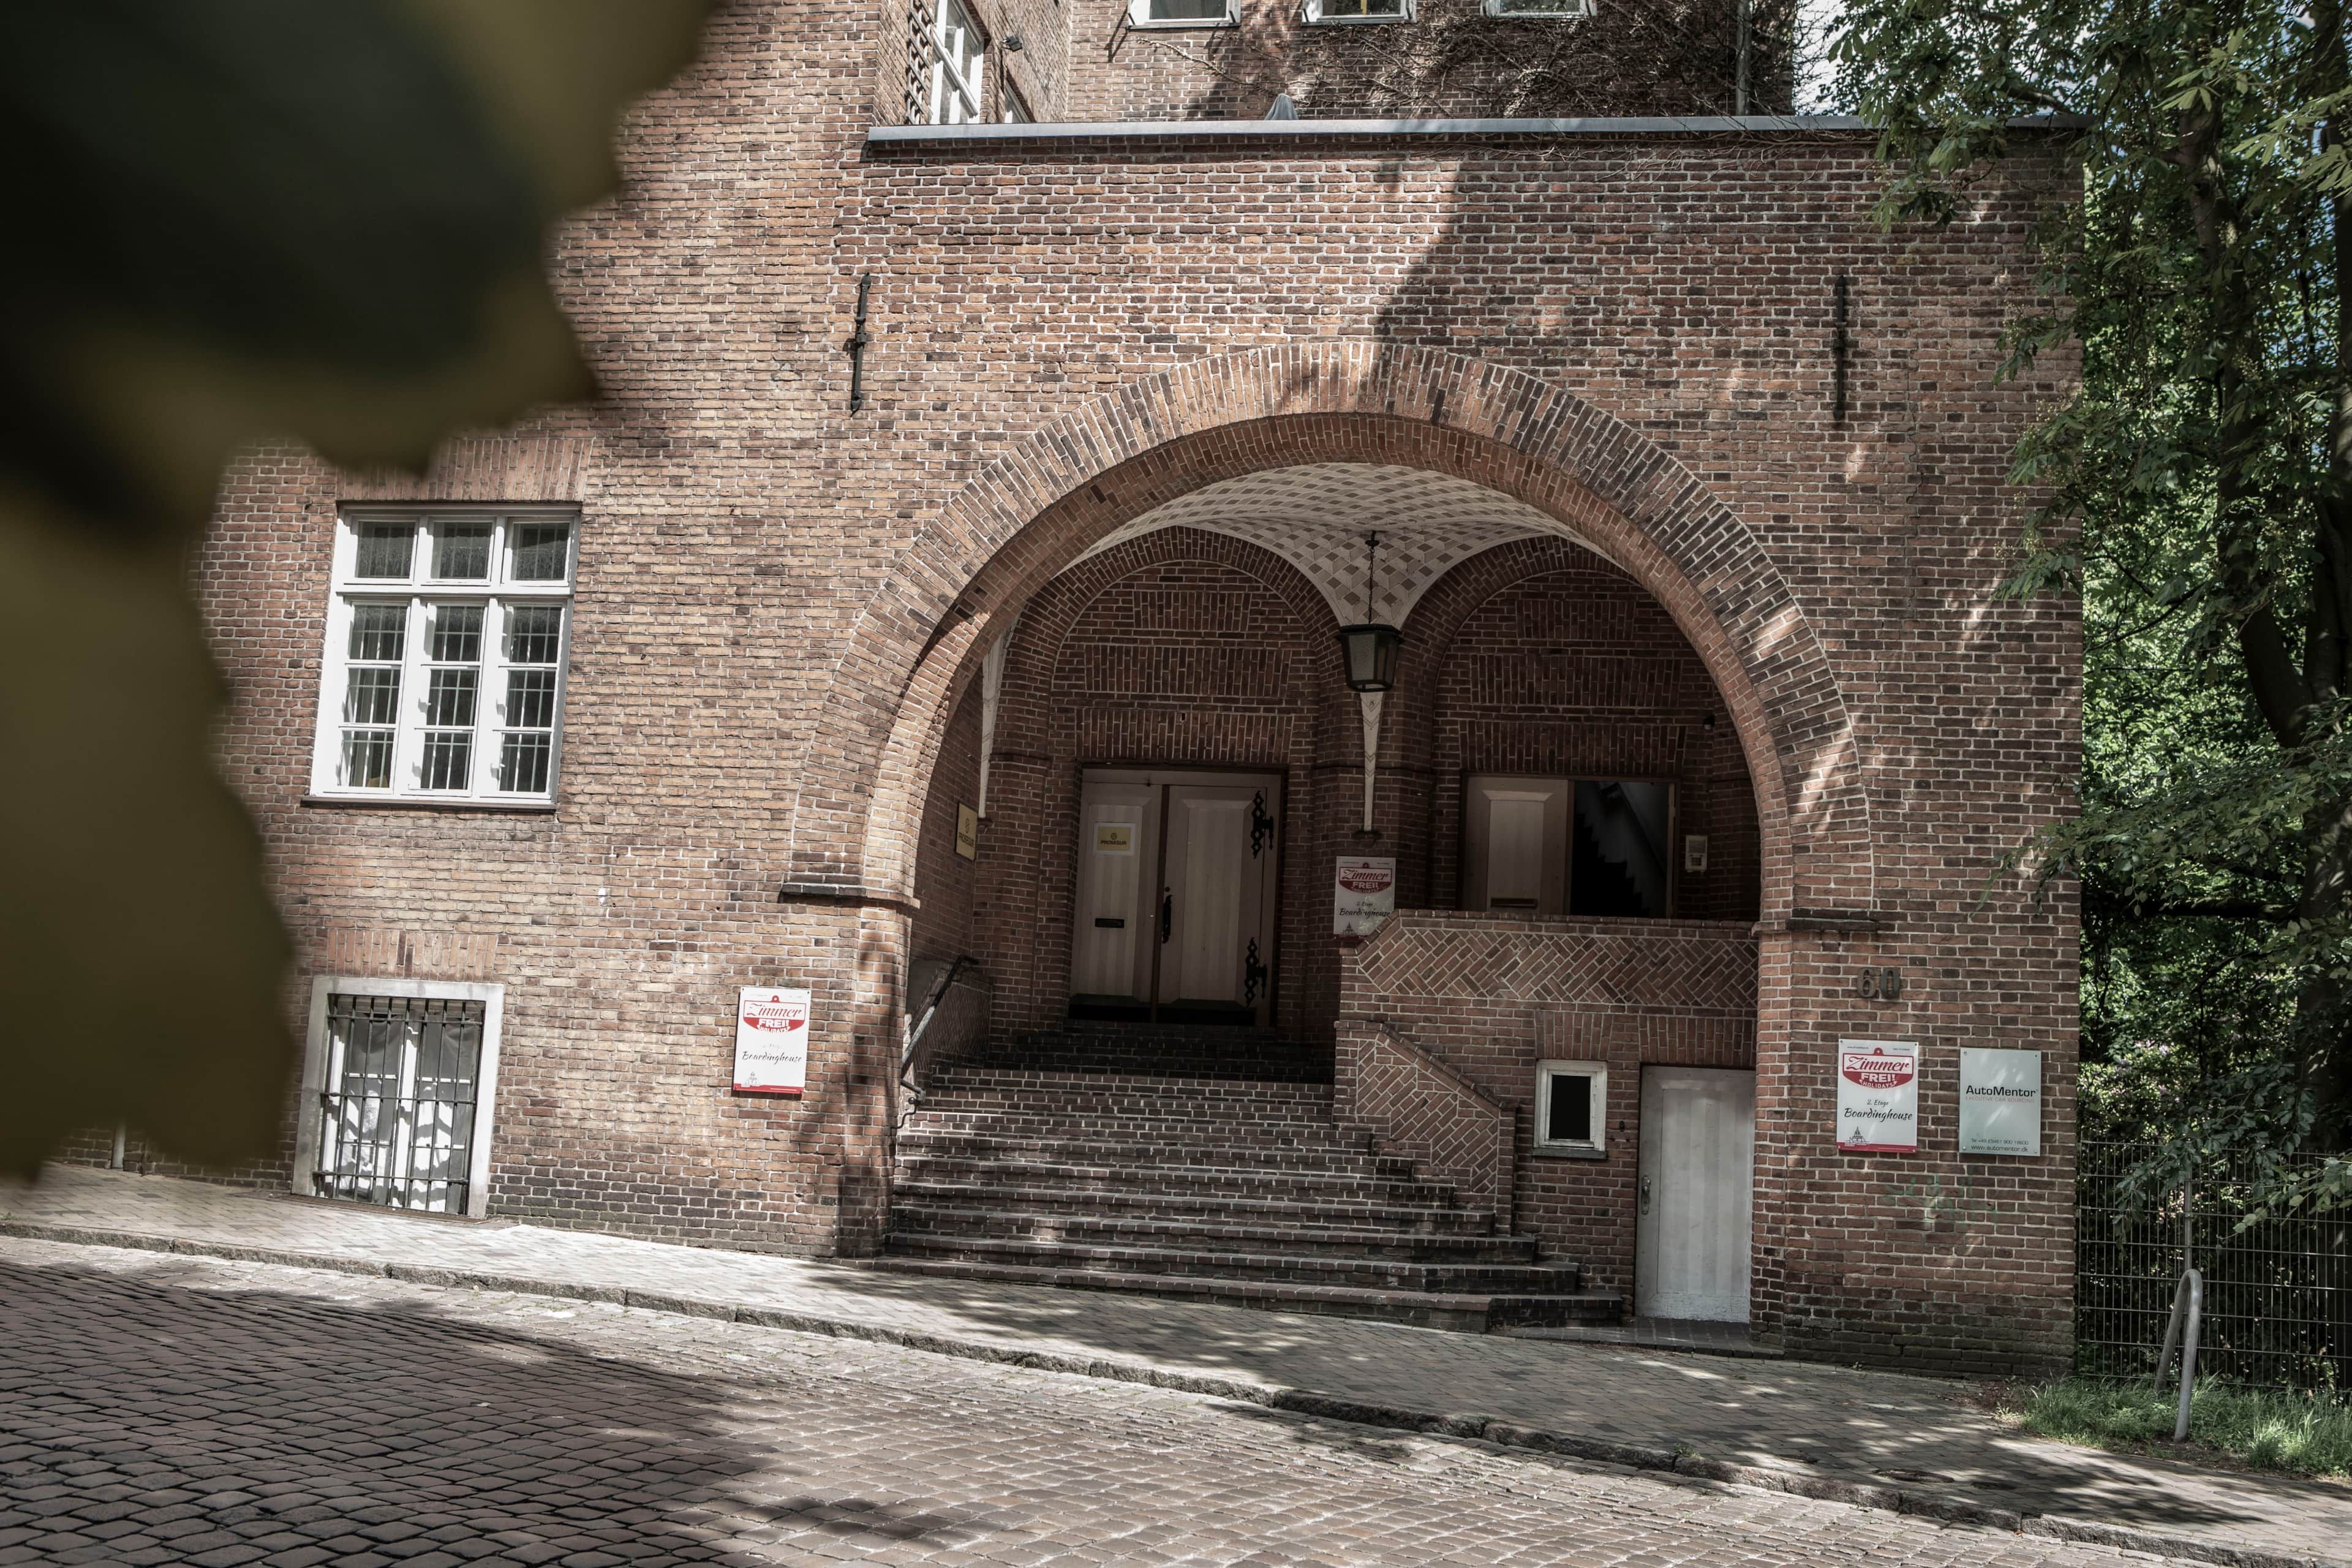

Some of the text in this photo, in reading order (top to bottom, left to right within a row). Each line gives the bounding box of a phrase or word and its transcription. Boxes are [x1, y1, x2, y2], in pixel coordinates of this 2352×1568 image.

[1342, 869, 1389, 881] Zimmer
[1339, 908, 1391, 919] Boardinghouse
[1857, 968, 1900, 998] 60
[746, 1003, 802, 1019] Zimmer
[758, 1018, 790, 1028] FREI!
[742, 1050, 802, 1065] Boardinghouse
[1845, 1056, 1910, 1072] Zimmer
[1861, 1072, 1896, 1082] FREI!
[1863, 1080, 1894, 1088] HOLIDAYS
[1966, 1085, 2037, 1097] AutoMentor
[1844, 1107, 1913, 1122] Boardinghouse
